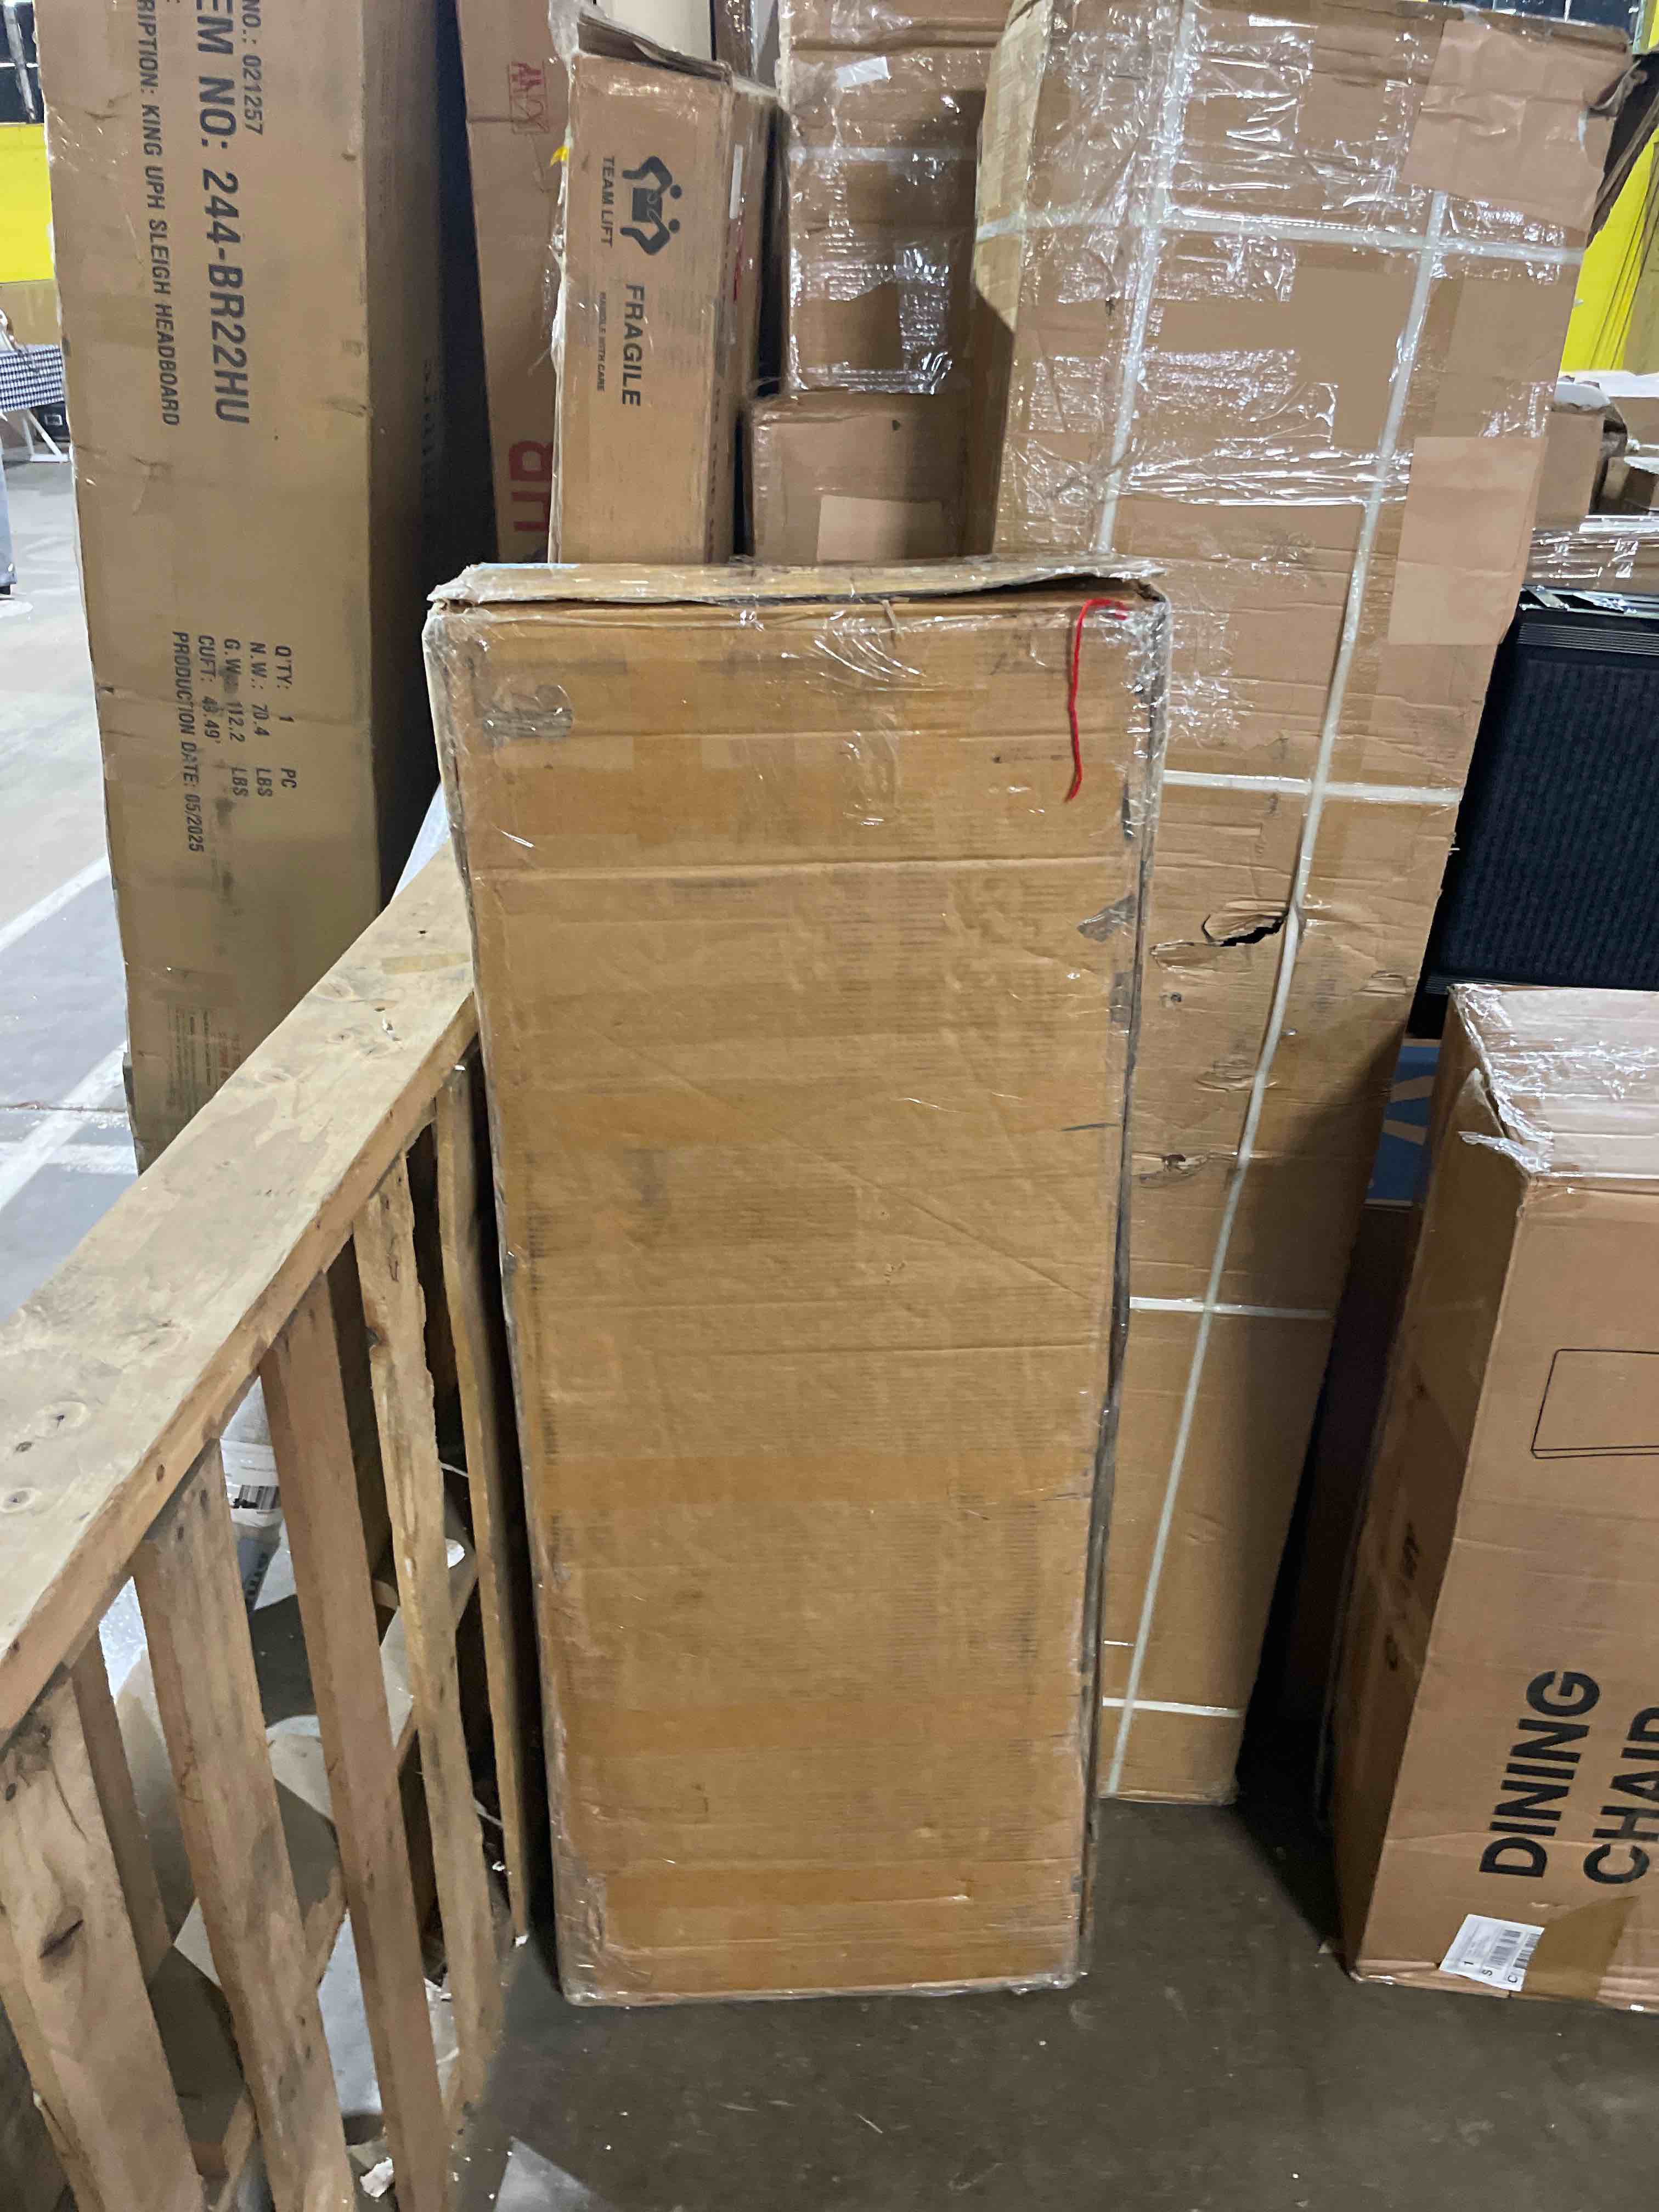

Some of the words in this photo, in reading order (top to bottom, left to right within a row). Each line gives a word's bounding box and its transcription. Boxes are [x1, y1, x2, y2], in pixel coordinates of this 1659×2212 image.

[199, 76, 236, 149] NO:
[242, 55, 263, 136] 021257
[142, 104, 163, 156] KING
[145, 166, 165, 210] UPH
[602, 156, 615, 205] TEAM
[601, 210, 614, 249] LIFT
[149, 219, 171, 295] SLEIGH
[202, 168, 250, 424] 244-BR22HU
[155, 303, 180, 426] HEADBOARD
[622, 283, 645, 407] FRAGILE
[596, 364, 605, 392] CARE
[198, 635, 216, 682] CUFT:
[250, 641, 267, 690] N.W.:
[275, 645, 292, 690] Q'TY:
[172, 631, 195, 736] PRODUCTION
[251, 704, 270, 737] 70.4
[180, 741, 199, 787] DATE:
[231, 766, 249, 797] LBS
[256, 768, 273, 797] LBS
[281, 768, 297, 788] PC
[184, 793, 205, 853] 05/2025
[1479, 1671, 1600, 1878] DINING
